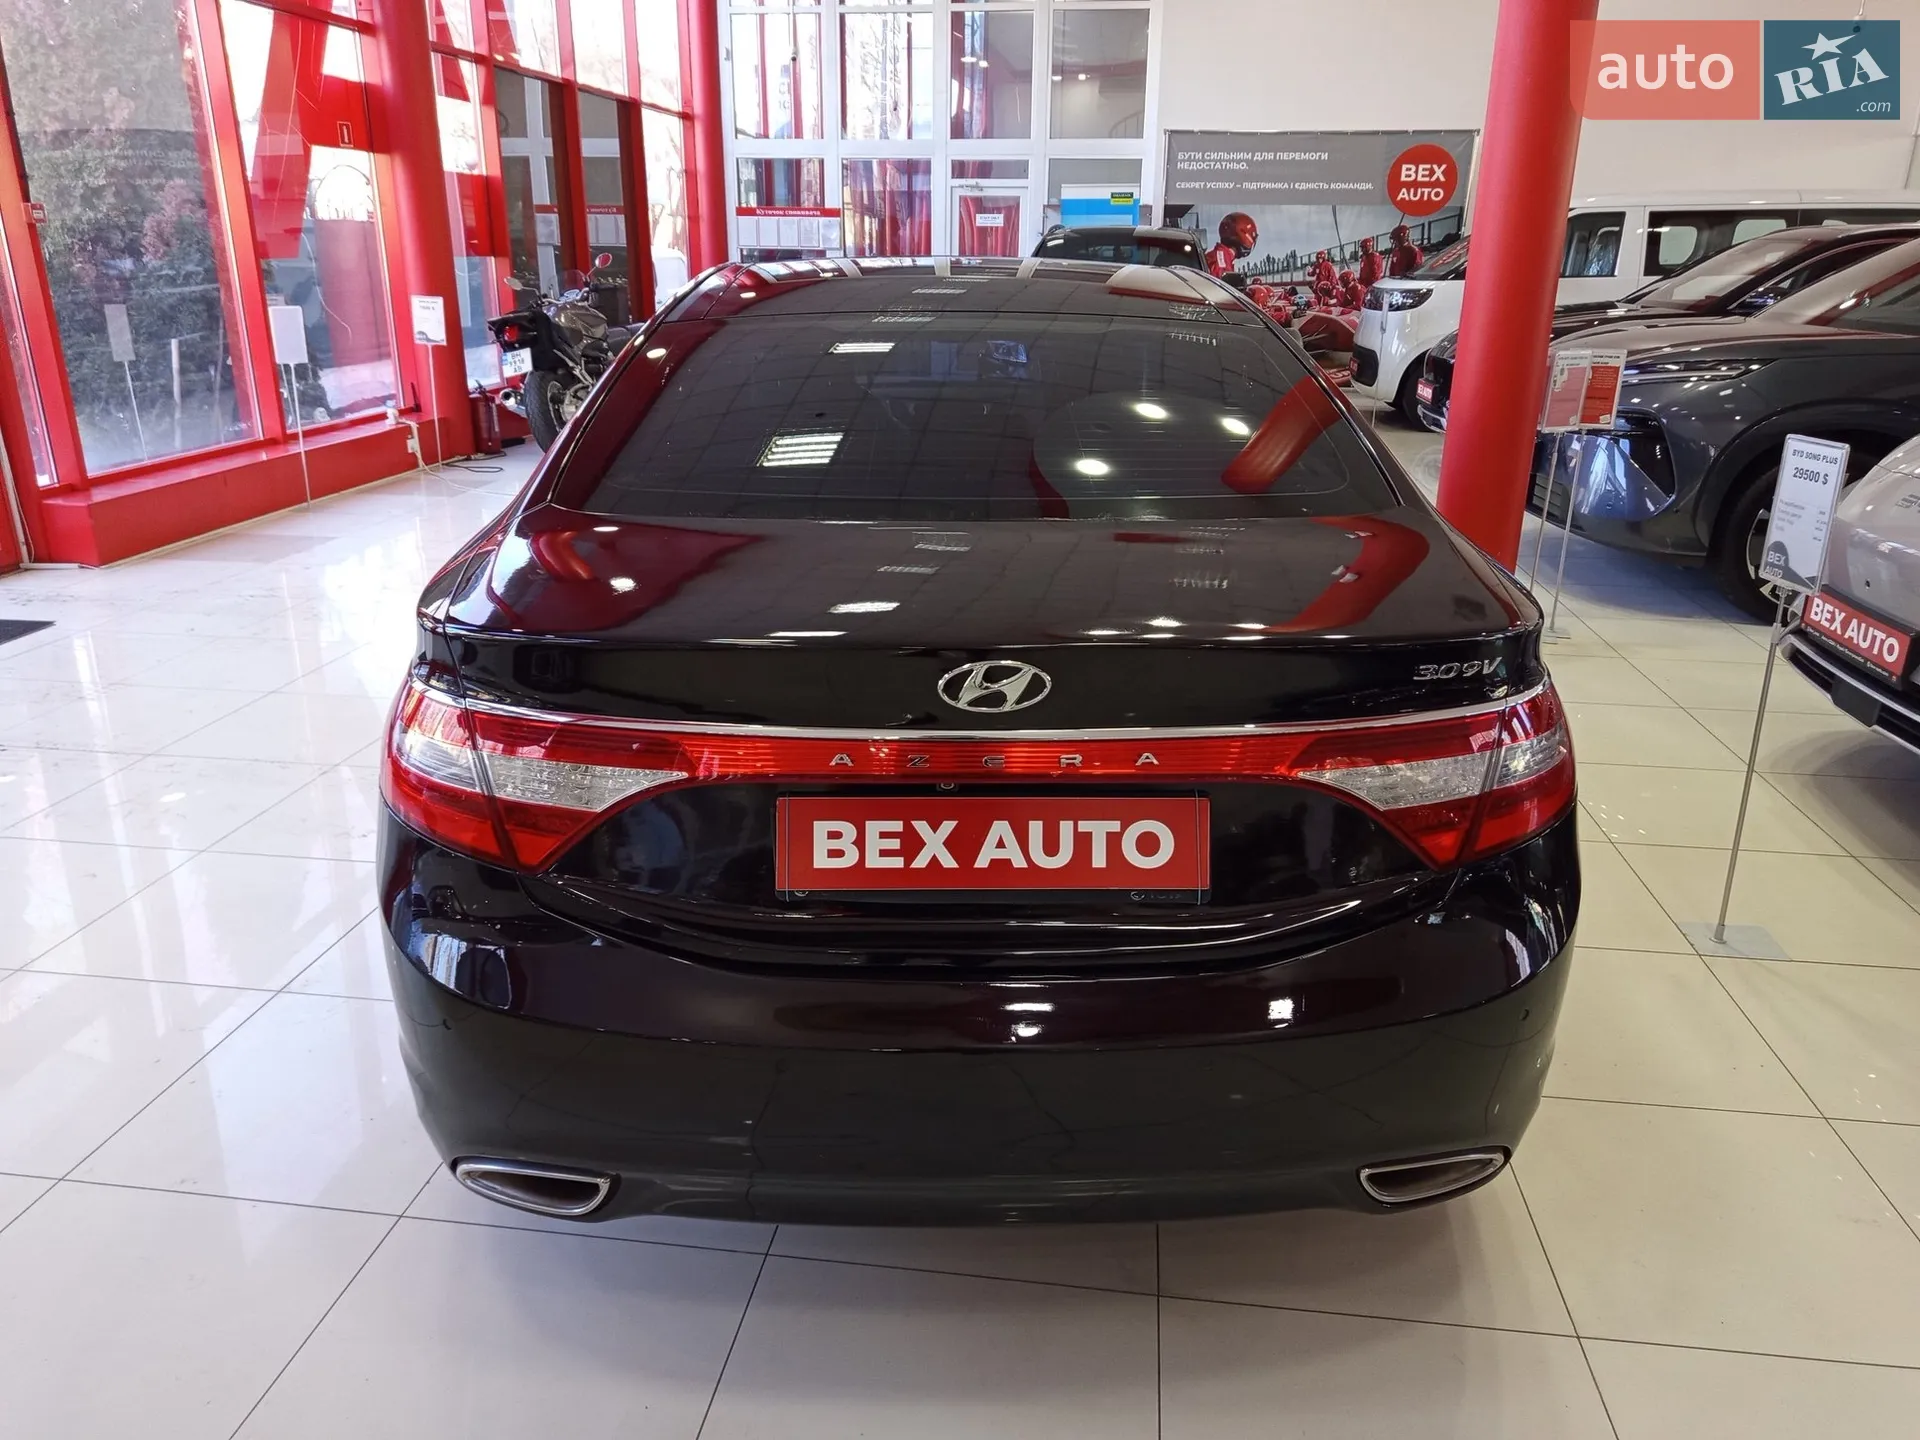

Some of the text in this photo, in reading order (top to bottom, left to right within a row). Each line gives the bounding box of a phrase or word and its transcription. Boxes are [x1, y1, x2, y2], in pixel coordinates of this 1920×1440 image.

[1178, 151, 1329, 161] БУТИ СИЛЬНИМ ДЛЯ ПЕРЕМОГИ
[1177, 161, 1249, 170] НЕДОСТАТНЬО.
[1400, 164, 1447, 182] BEX
[1243, 182, 1289, 190] ПІДТРИМКА
[1295, 182, 1329, 190] ЄДНІСТЬ
[1330, 182, 1374, 190] КОМАНДИ.
[1396, 188, 1444, 201] AUTO
[1792, 449, 1838, 465] BYD SONG PLUS
[1792, 467, 1829, 485] 29500 $
[1767, 551, 1786, 567] BEX
[1764, 566, 1783, 578] AUTO
[1810, 597, 1846, 635] BEX
[1844, 618, 1900, 663] AUTO
[829, 752, 1159, 768] AZERA
[812, 820, 1176, 869] BEX AUTO
